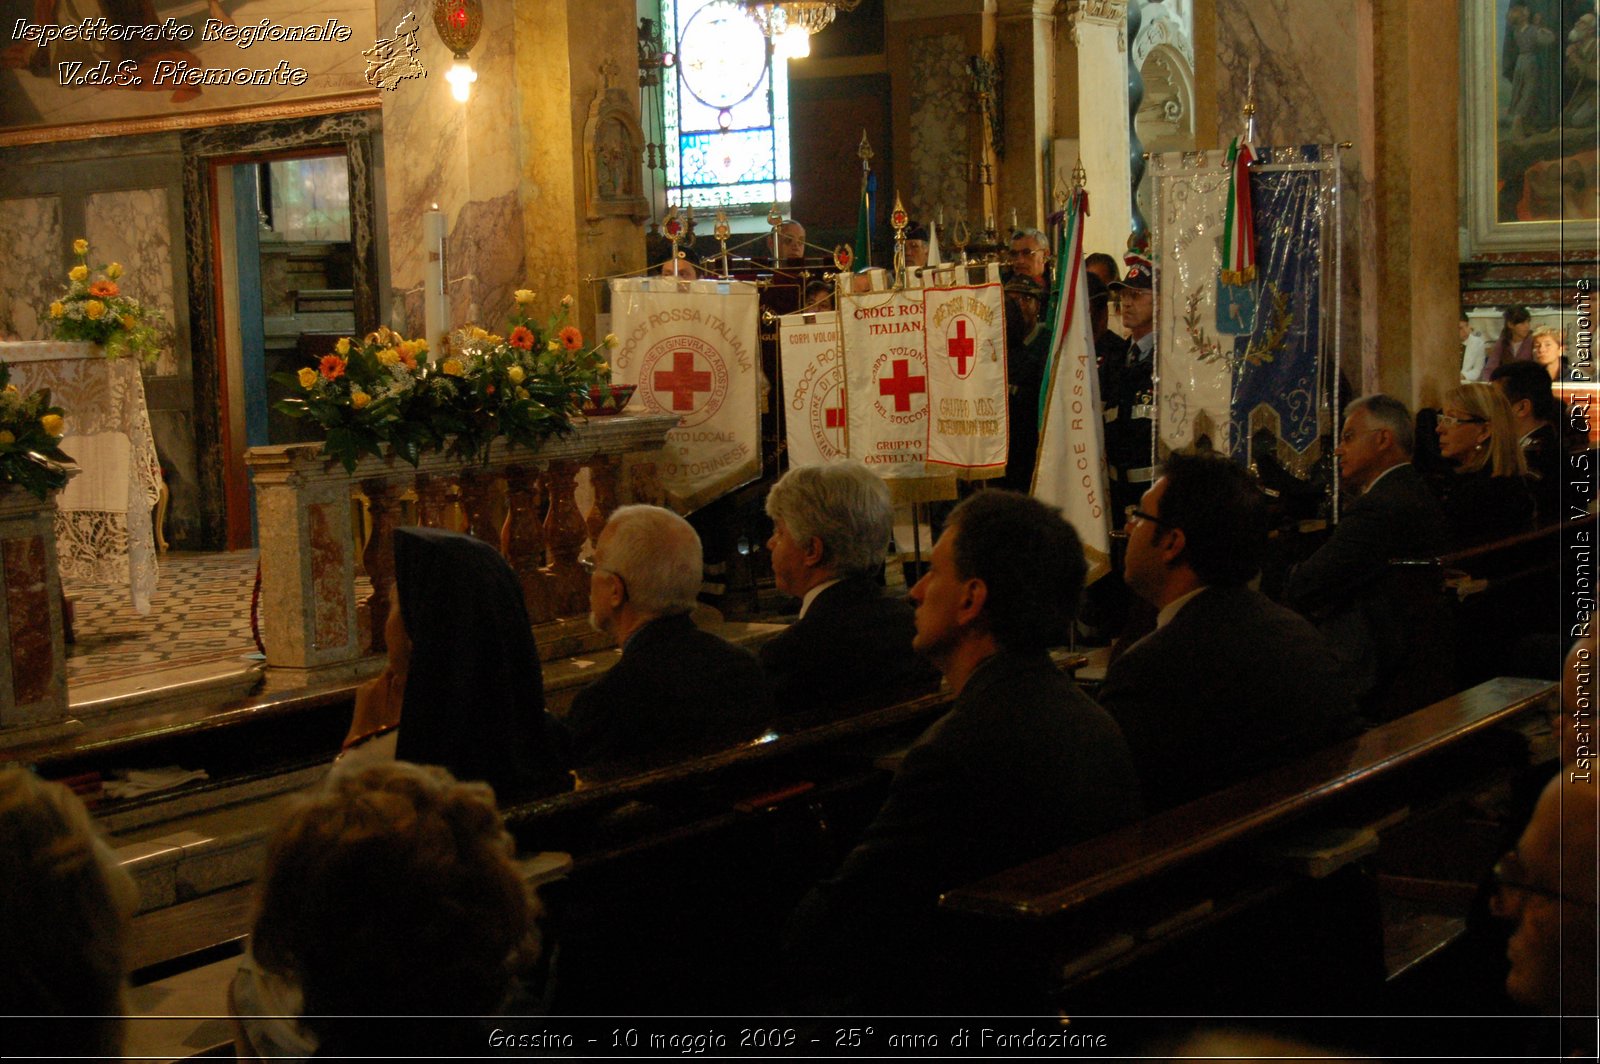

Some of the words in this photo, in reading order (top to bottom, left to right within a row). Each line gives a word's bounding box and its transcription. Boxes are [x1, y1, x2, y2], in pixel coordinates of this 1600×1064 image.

[854, 305, 895, 320] CROCE
[617, 323, 649, 370] CROCE
[648, 307, 702, 328] ROSSA
[704, 313, 752, 374] ITALIANA
[789, 332, 810, 345] CORPI
[665, 338, 705, 352] GINEVRA
[703, 347, 716, 361] 22
[711, 358, 726, 398] AGOSTO
[792, 361, 818, 411] CROCE
[819, 378, 831, 392] DI
[1070, 353, 1089, 432] ROSSA
[874, 400, 887, 419] DEL
[693, 431, 736, 442] LOCALE
[876, 439, 922, 451] GRUPPO
[681, 441, 750, 477] TORINESE
[1075, 442, 1103, 521] CROCE
